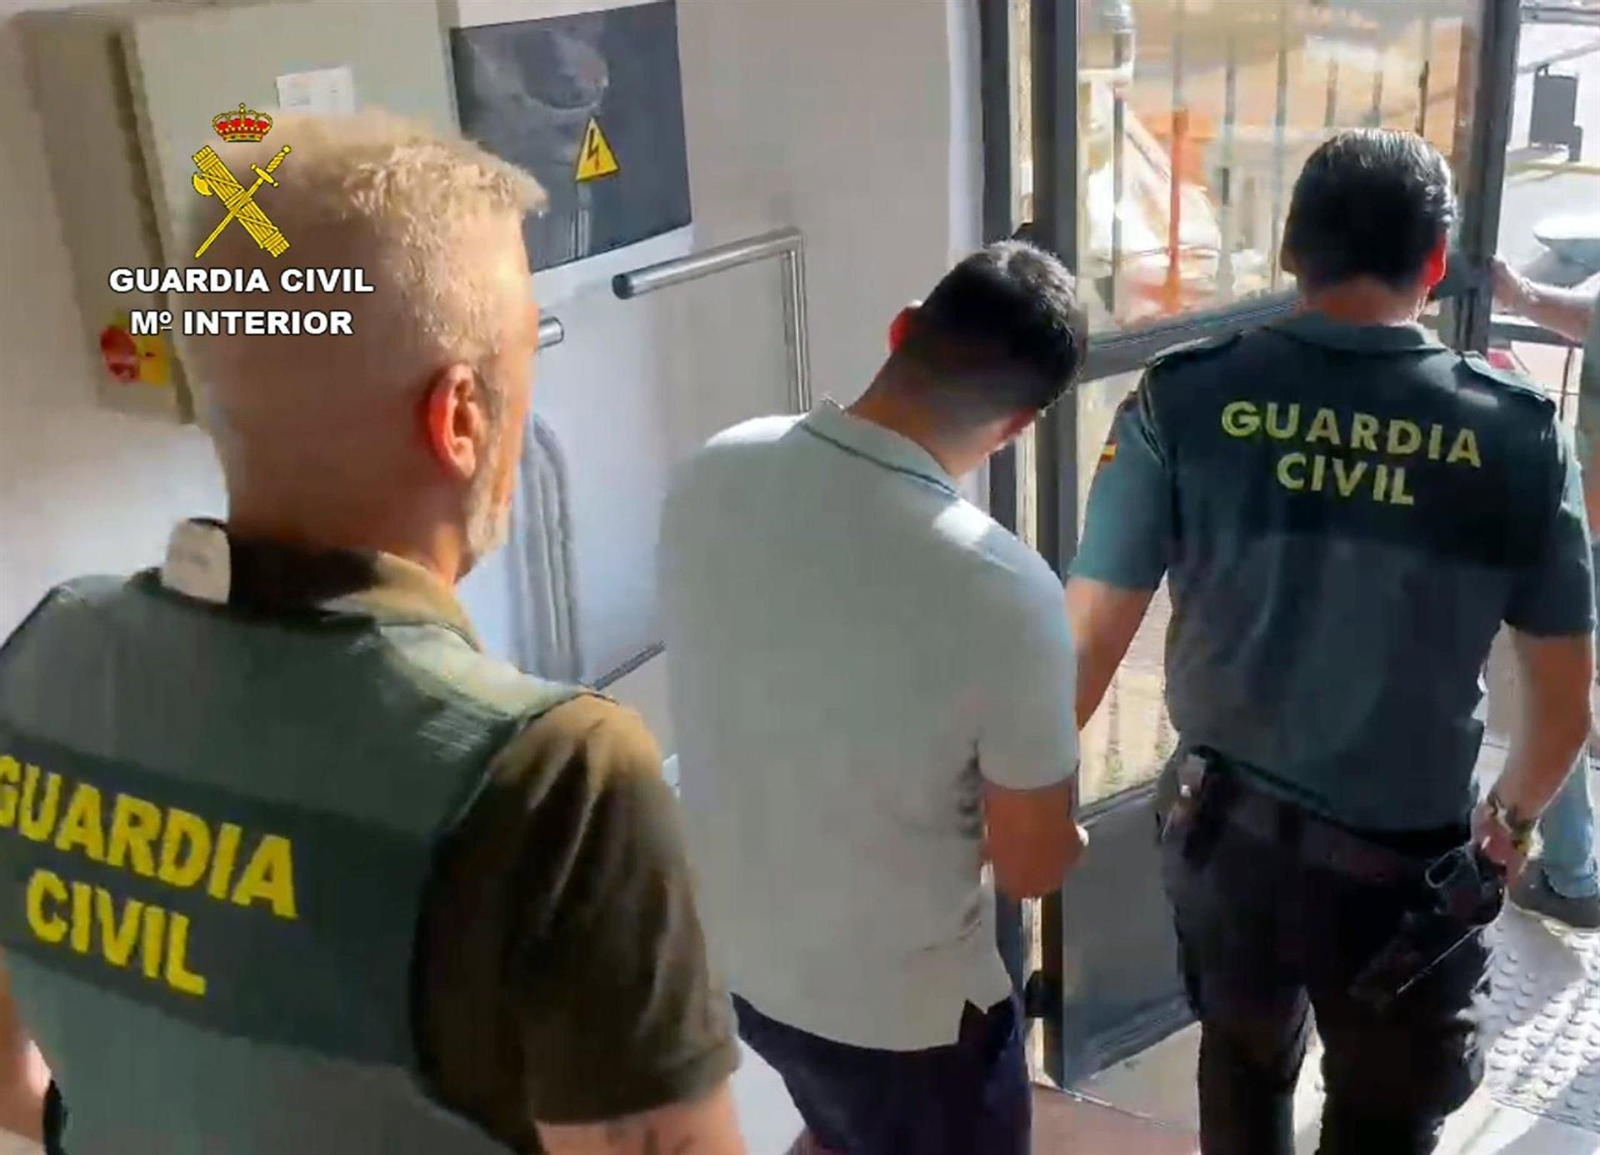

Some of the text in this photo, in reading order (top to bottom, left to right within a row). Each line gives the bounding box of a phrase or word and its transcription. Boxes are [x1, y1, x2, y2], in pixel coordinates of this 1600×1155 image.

[1221, 401, 1481, 468] GUARDIA
[1276, 452, 1415, 505] CIVIL
[0, 755, 297, 919] GUARDIA
[27, 868, 206, 996] CIVIL
